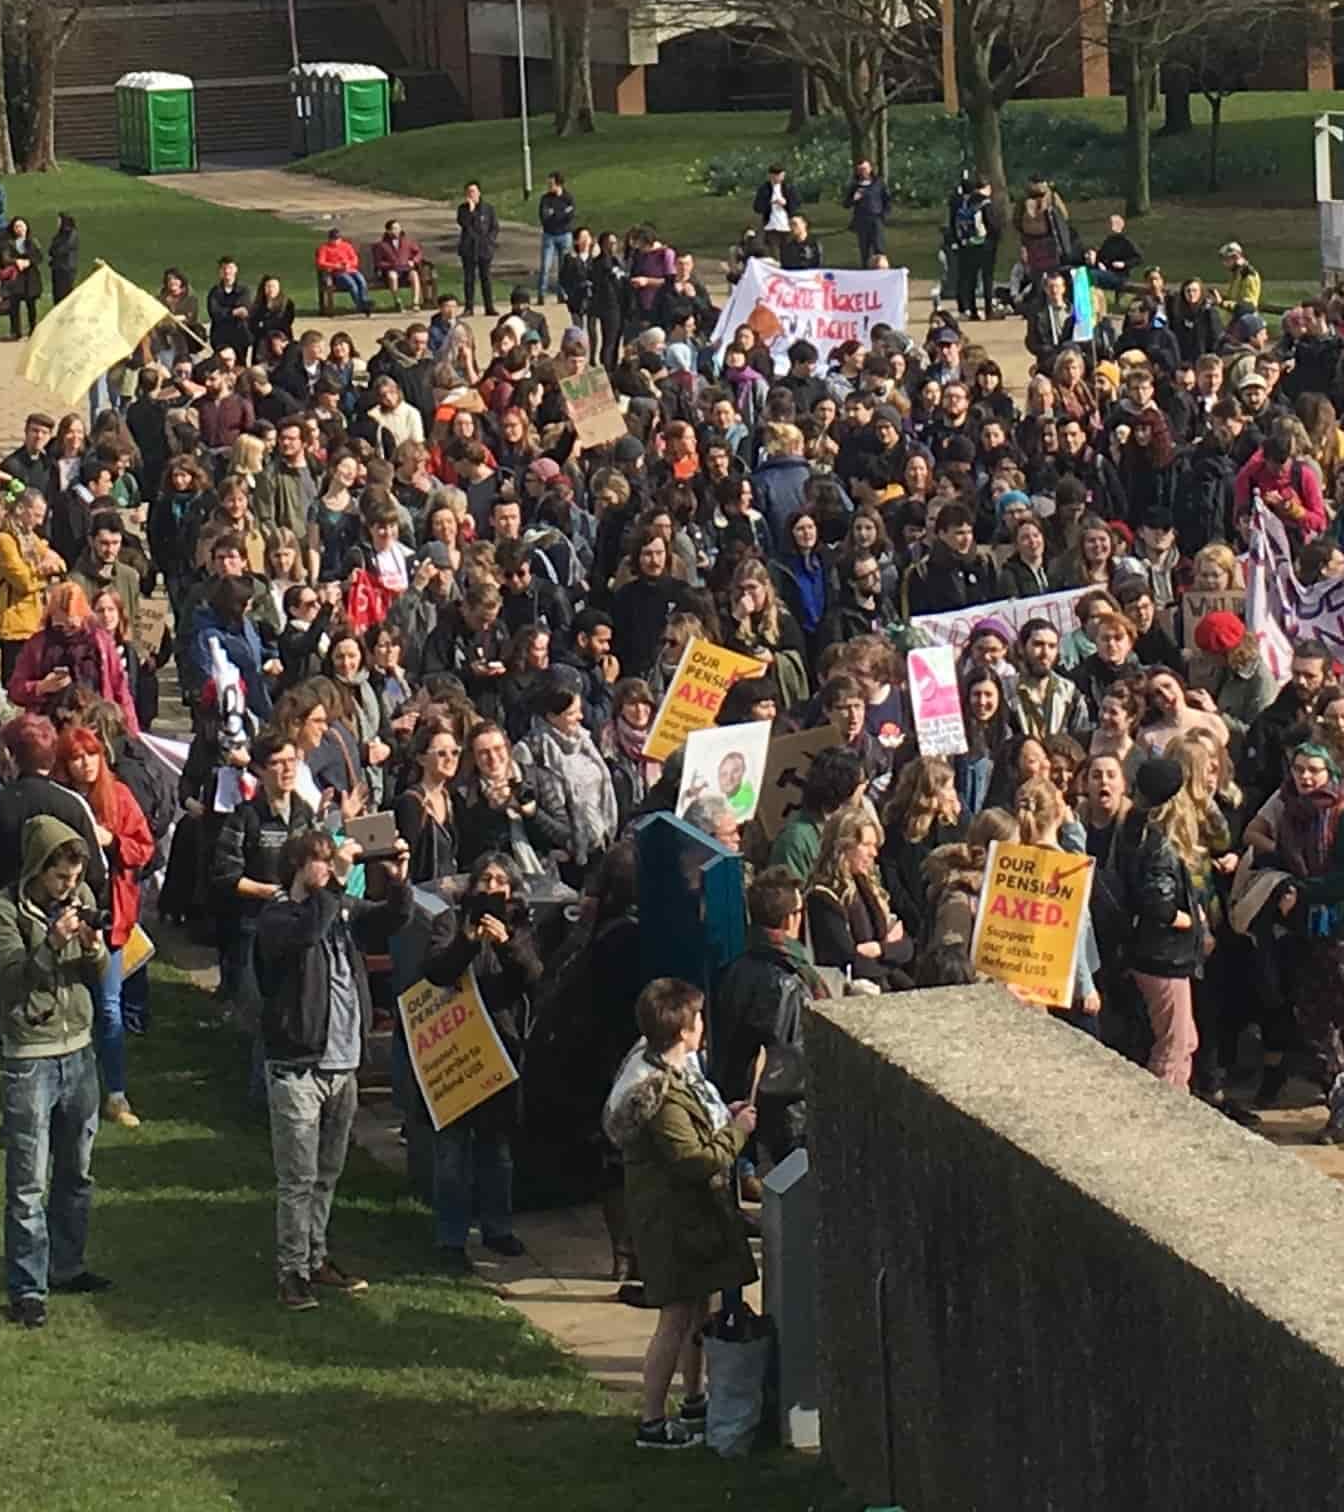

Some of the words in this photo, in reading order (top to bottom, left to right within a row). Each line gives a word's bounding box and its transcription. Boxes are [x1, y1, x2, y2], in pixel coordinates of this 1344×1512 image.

[677, 681, 722, 713] AXE
[999, 855, 1036, 875] OUR
[995, 873, 1075, 900] PENSION
[990, 893, 1070, 928] AXED.
[986, 925, 1035, 944] Support
[981, 955, 1022, 973] defend
[415, 1004, 475, 1057] AXED.
